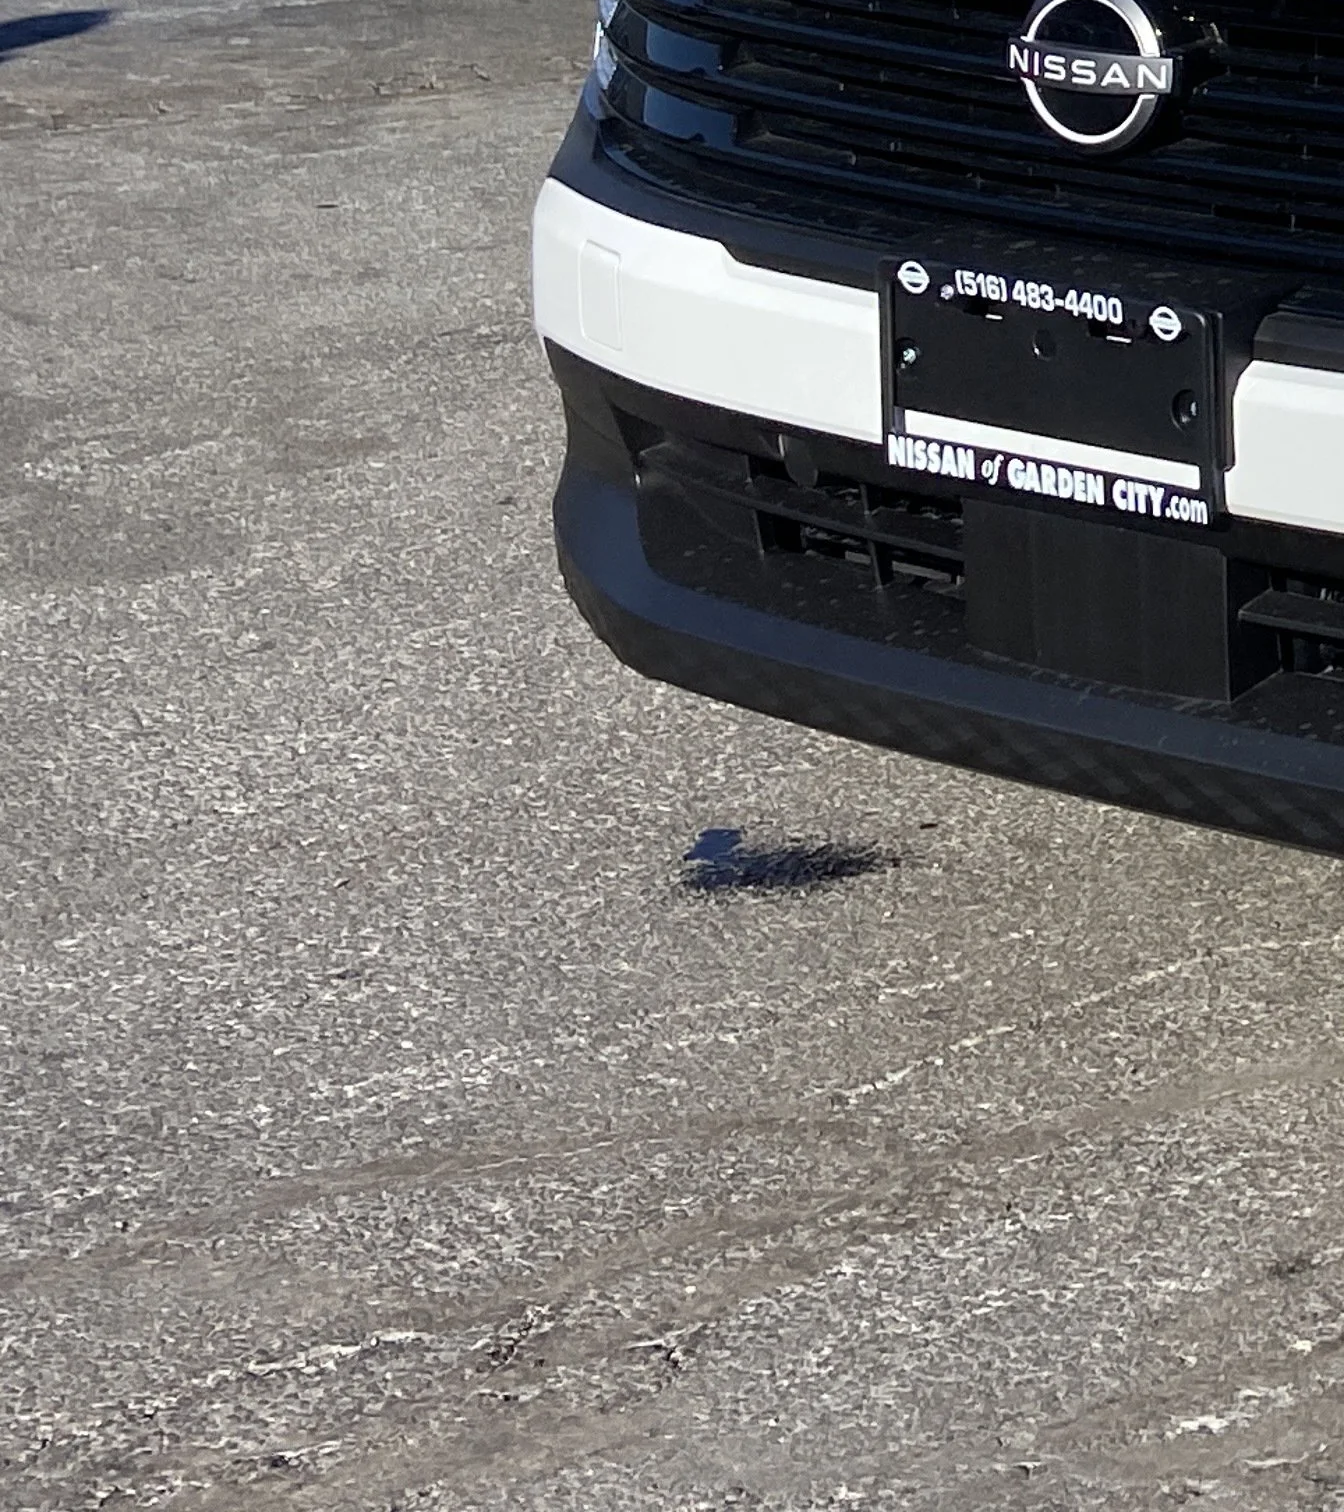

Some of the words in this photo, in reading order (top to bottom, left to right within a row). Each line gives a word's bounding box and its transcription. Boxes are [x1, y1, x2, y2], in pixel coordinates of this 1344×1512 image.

[1009, 44, 1167, 89] NISSAN
[955, 269, 1007, 302] (516)
[1012, 279, 1124, 324] 483-4400
[887, 433, 975, 480] NISSAN
[981, 454, 1004, 486] of
[1007, 458, 1105, 506] GARDEN
[1111, 478, 1209, 525] CITY.com
